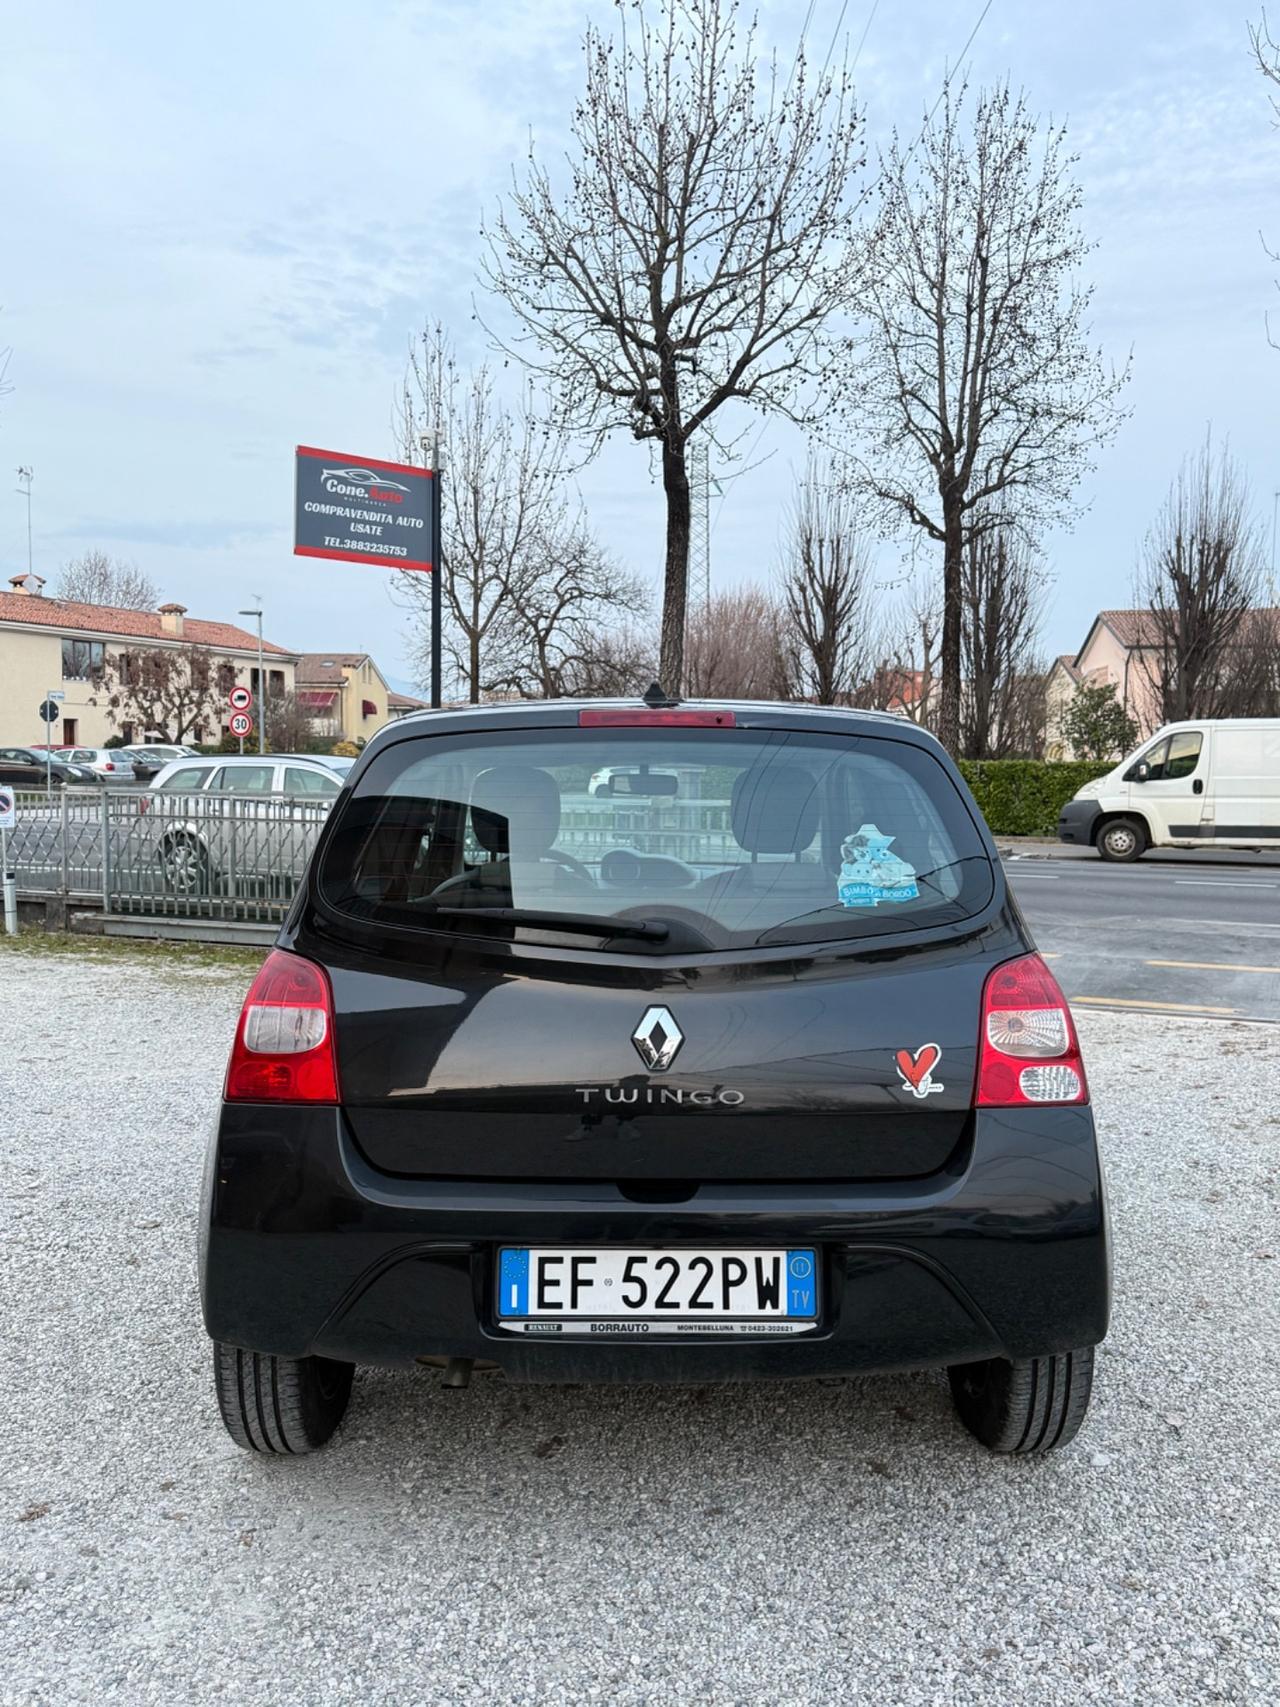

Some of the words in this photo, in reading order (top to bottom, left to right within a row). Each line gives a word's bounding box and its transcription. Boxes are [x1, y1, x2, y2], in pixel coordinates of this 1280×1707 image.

[304, 501, 393, 524] COMPRAVENDITA
[395, 516, 424, 529] AUTO
[349, 522, 384, 536] USATE
[323, 536, 408, 557] TEL.3883235753
[234, 718, 247, 730] 30
[575, 1088, 745, 1105] TWINGO
[537, 1256, 597, 1310] EF
[621, 1256, 780, 1310] 522PW
[791, 1289, 810, 1309] TV
[590, 1323, 650, 1332] BORRAUTO
